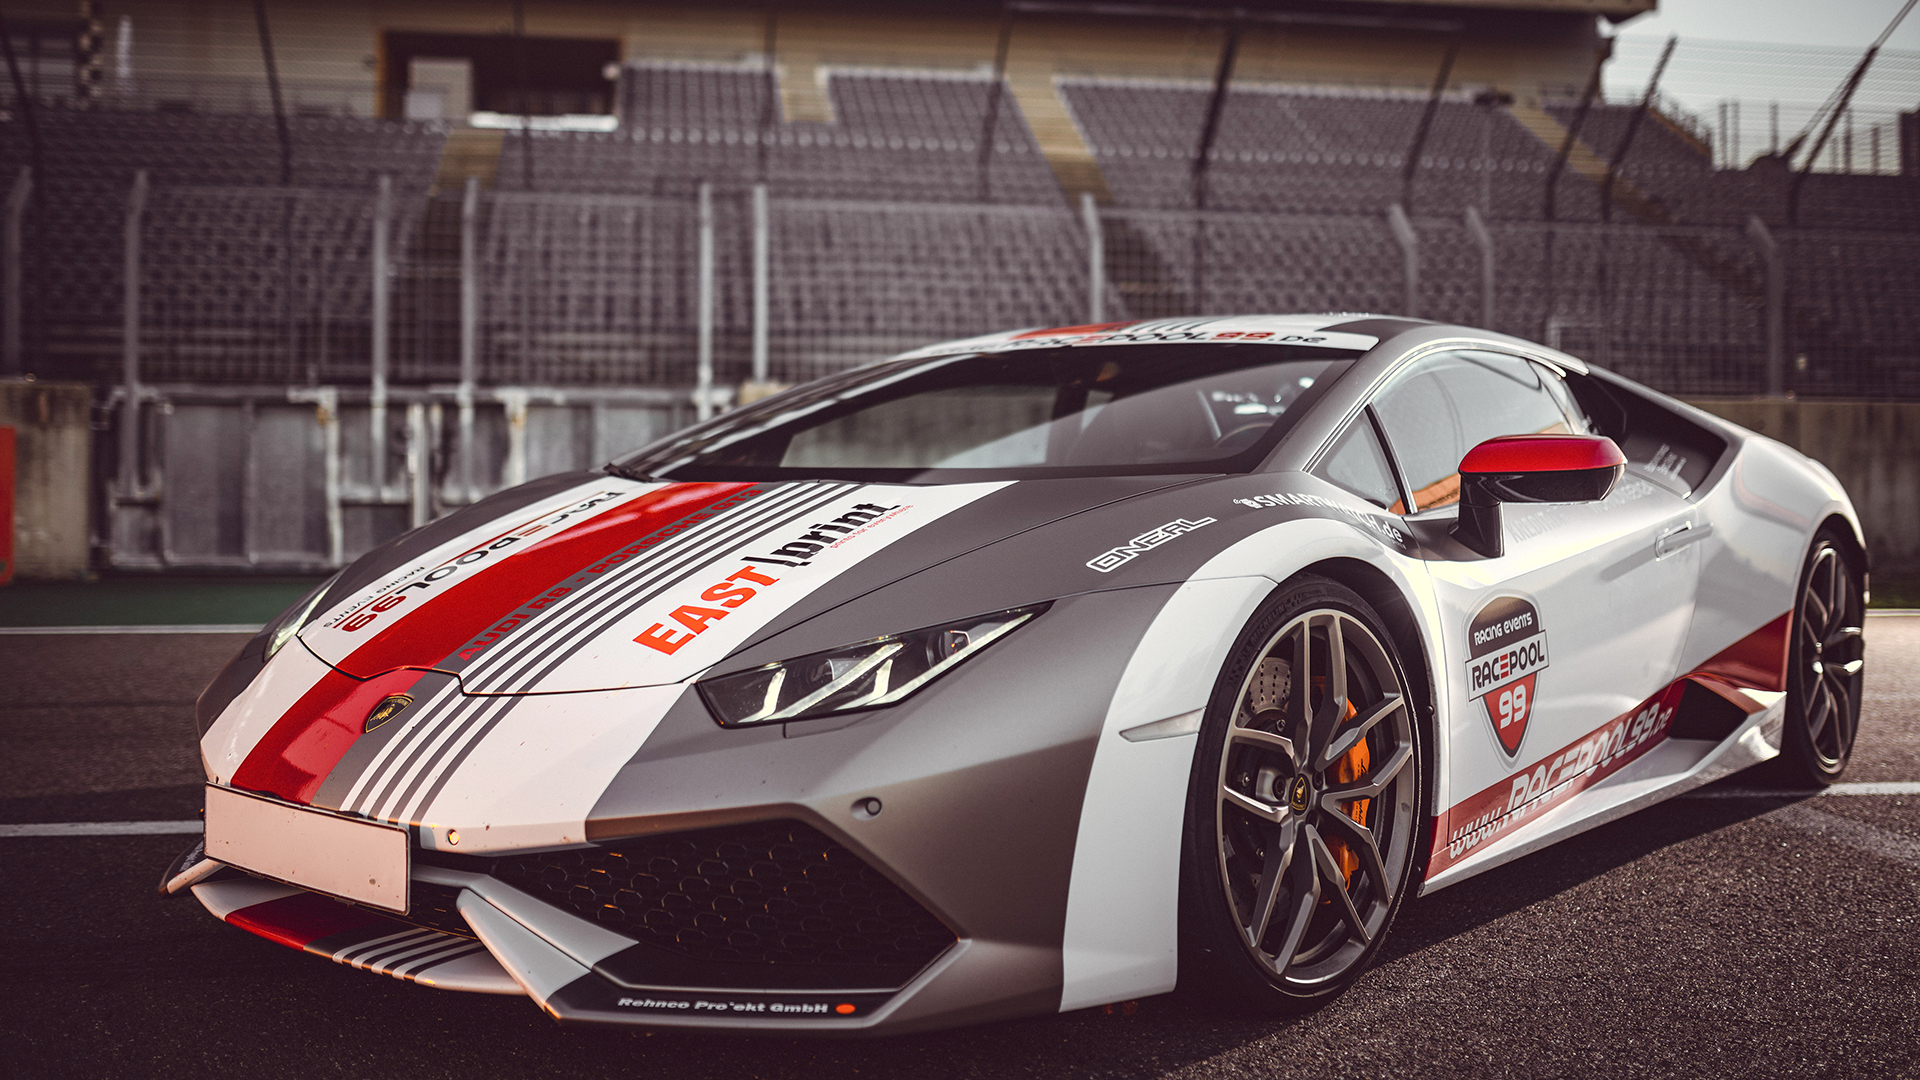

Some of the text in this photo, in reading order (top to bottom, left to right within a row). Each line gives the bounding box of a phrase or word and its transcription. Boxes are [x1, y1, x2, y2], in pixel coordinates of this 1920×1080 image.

[323, 566, 425, 629] RACING EVENTS
[458, 613, 530, 661] AUDI
[534, 586, 572, 610] R8
[586, 512, 714, 576] PORSCHE
[711, 489, 763, 511] GT3
[632, 565, 780, 655] EAST
[1473, 622, 1503, 646] RACING
[1471, 640, 1546, 692] RACEPOOL
[1498, 684, 1527, 730] 99
[769, 1003, 829, 1014] GmbH
